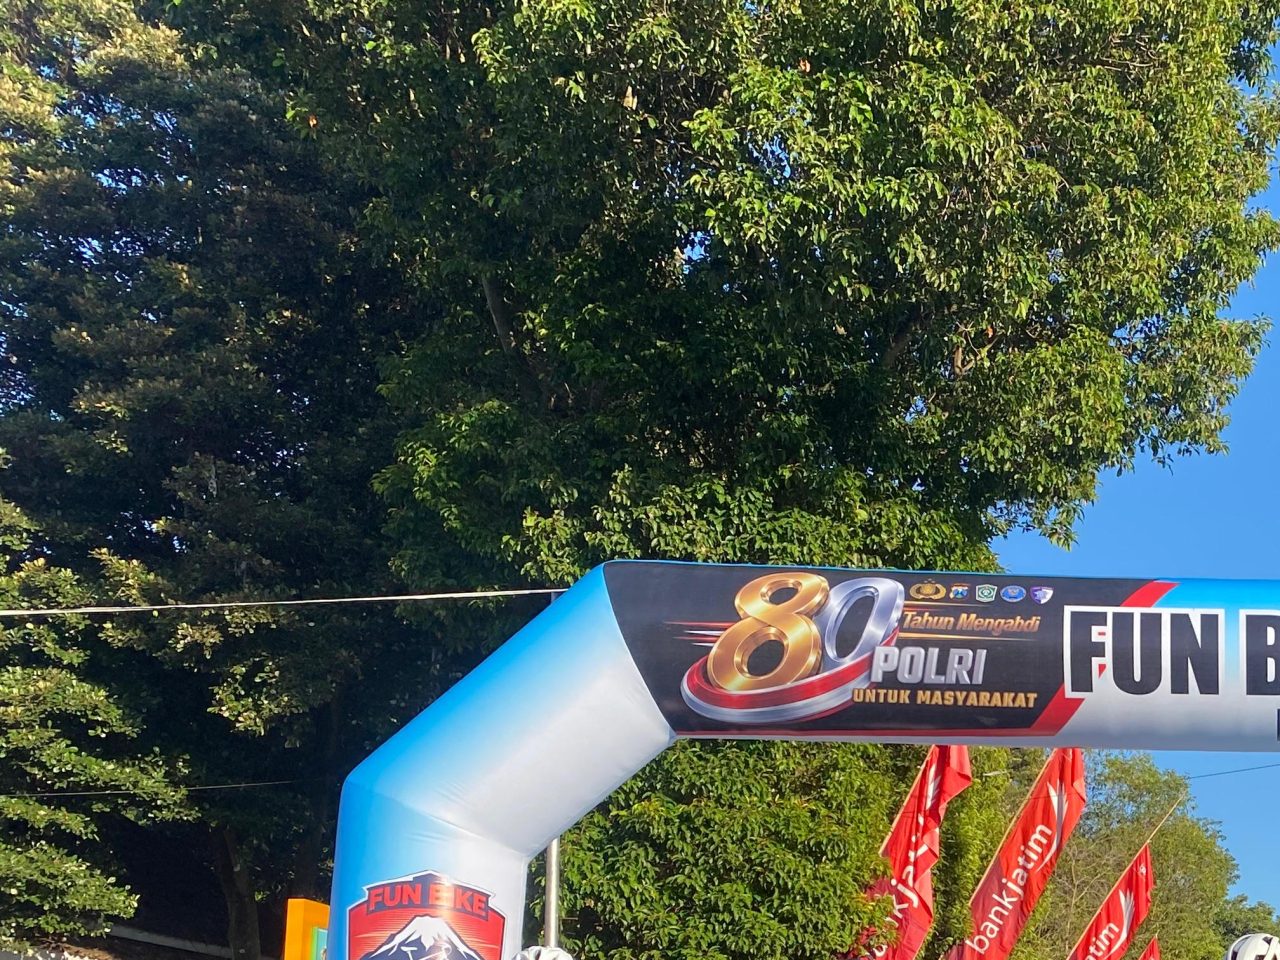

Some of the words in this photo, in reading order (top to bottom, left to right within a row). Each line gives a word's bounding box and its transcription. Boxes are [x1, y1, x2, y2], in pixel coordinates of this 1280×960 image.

[707, 571, 905, 691] 80
[903, 611, 955, 630] Tahun
[956, 613, 1041, 636] Mengabdi
[870, 645, 988, 685] POLRI
[1068, 609, 1221, 697] FUN
[853, 688, 911, 704] UNTUK
[916, 690, 1038, 709] MASYARAKAT
[368, 884, 423, 911] FUN
[965, 823, 1053, 955] bankjatim
